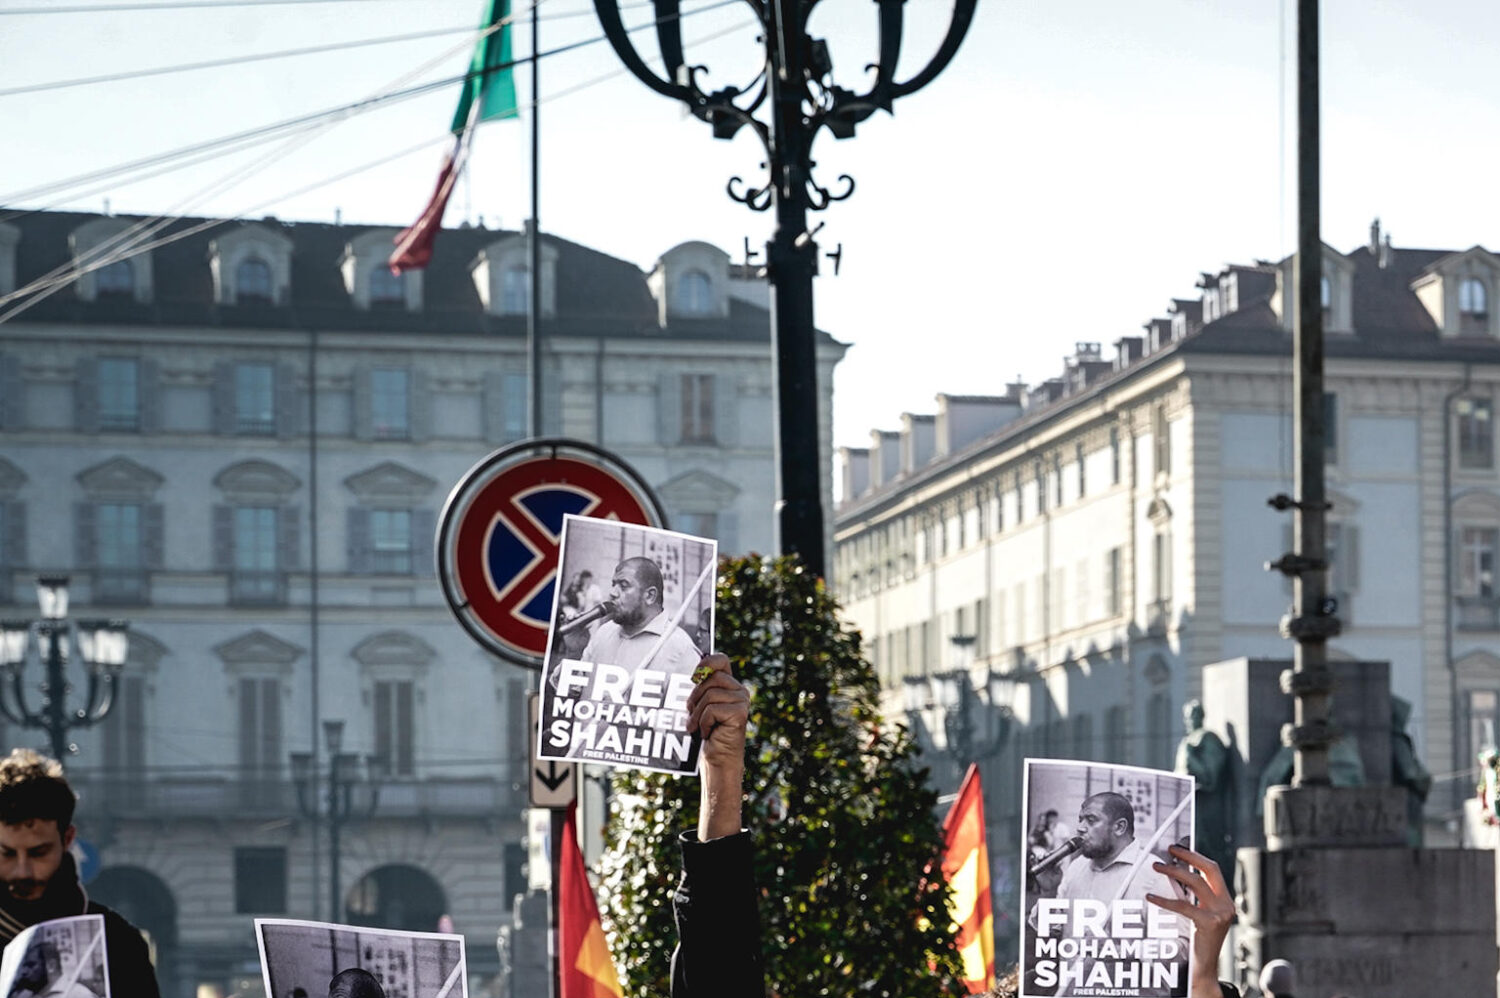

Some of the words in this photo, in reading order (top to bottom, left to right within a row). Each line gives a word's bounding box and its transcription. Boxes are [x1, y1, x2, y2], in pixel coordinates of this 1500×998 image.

[556, 659, 695, 709] FREE
[549, 720, 691, 762] SHAHIN
[583, 750, 604, 759] FREE
[605, 752, 649, 764] PALESTINE
[1037, 898, 1179, 938] FREE
[1035, 938, 1178, 960] MOHAMED
[1034, 961, 1178, 988] SHAHIN
[1073, 988, 1095, 996] FREE
[1095, 988, 1139, 996] PALESTINE
